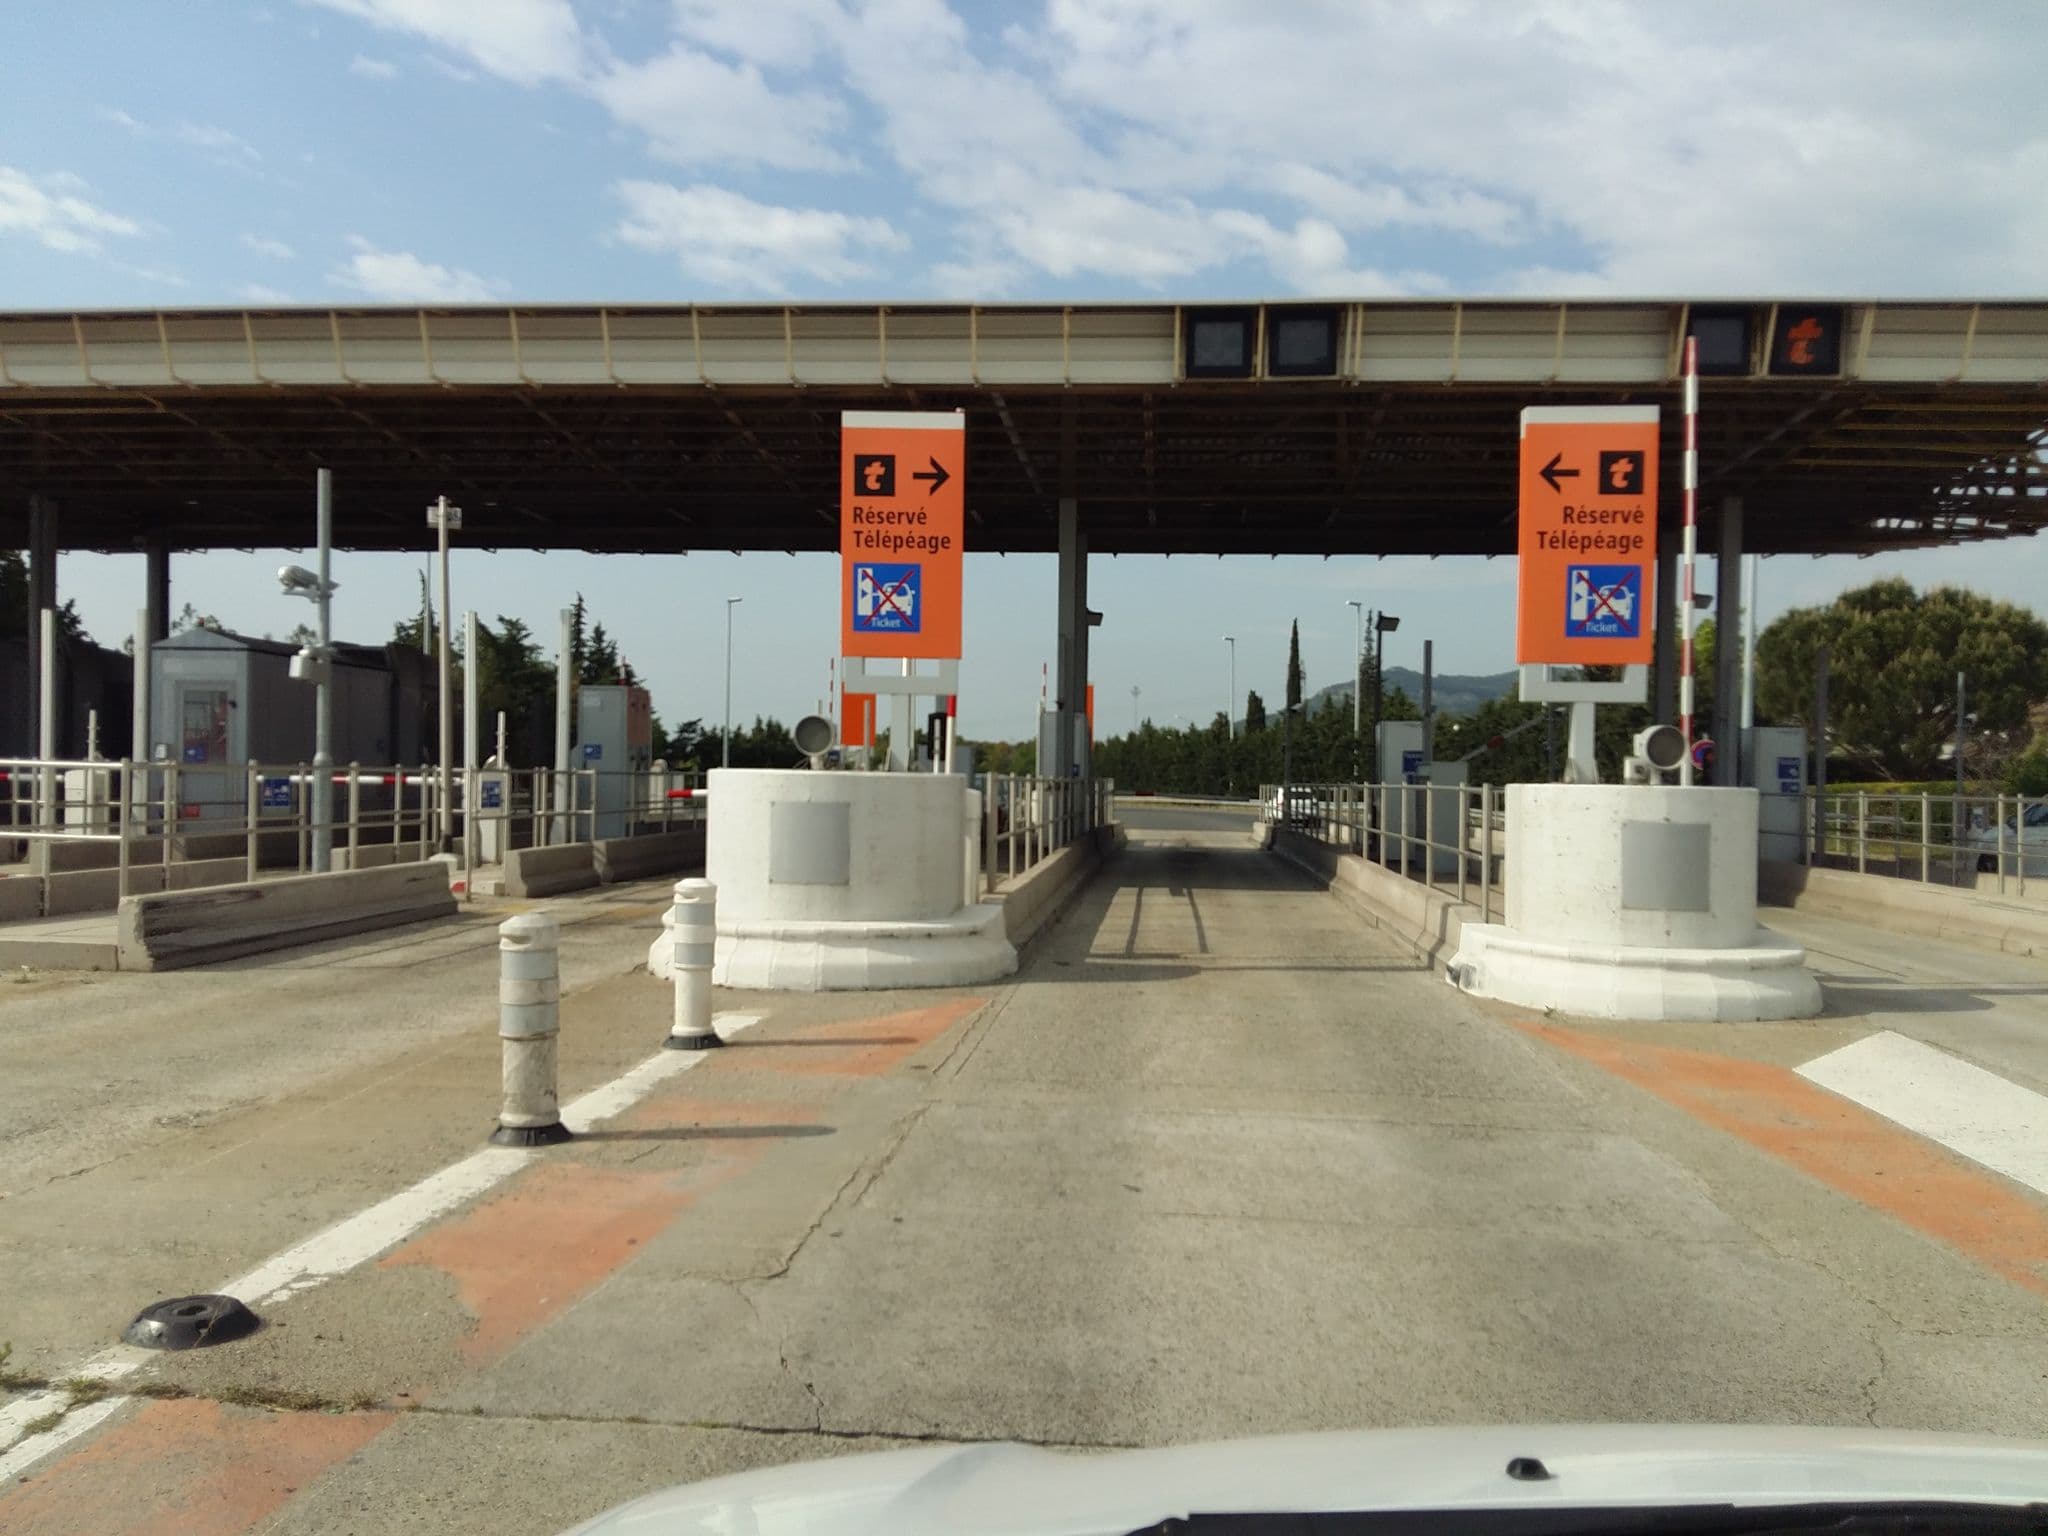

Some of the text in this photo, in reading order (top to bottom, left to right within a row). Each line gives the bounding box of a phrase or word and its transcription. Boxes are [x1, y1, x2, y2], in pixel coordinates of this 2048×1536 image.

[853, 506, 927, 526] Réservé
[1563, 505, 1644, 525] Réservé
[854, 529, 951, 554] Télépéage
[1537, 530, 1643, 554] Télépéage
[871, 617, 902, 628] Ticket
[1586, 622, 1617, 633] Ticket
